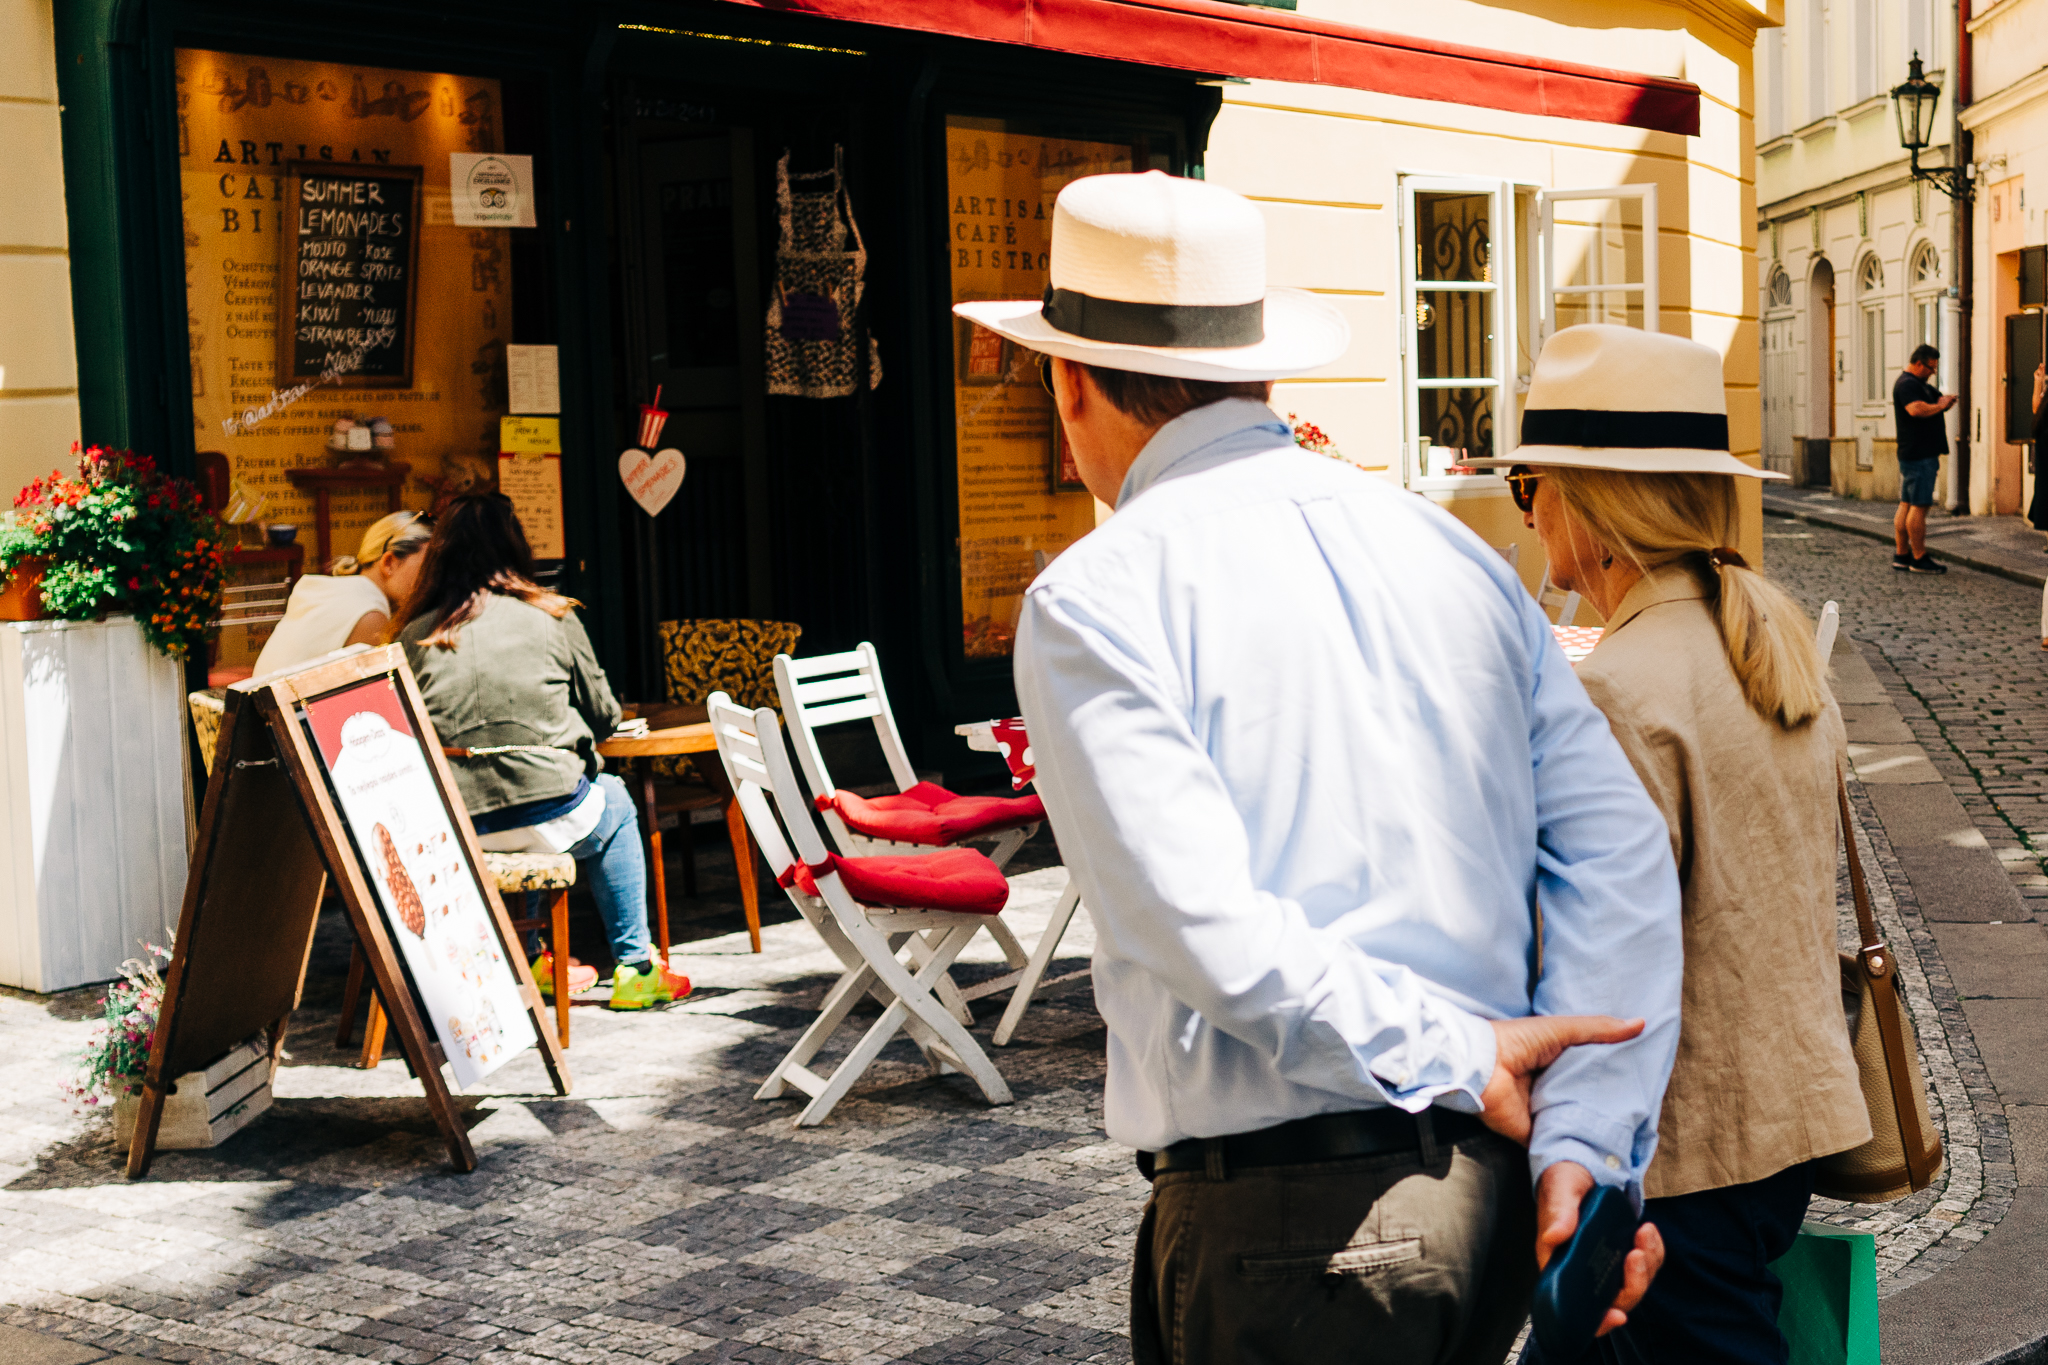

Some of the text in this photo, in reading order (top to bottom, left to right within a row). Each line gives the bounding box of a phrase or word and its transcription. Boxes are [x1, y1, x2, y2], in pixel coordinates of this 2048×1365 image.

[302, 179, 385, 205] SUMMER
[953, 195, 1055, 221] ARTISA
[299, 206, 402, 240] LEMONADES
[956, 221, 1018, 246] CAFÉ
[302, 240, 347, 258] MOJITO
[957, 248, 1050, 272] BISTRO
[300, 259, 355, 280] ORANGE
[300, 280, 375, 304] LEVANDER
[300, 302, 341, 323] KIWI
